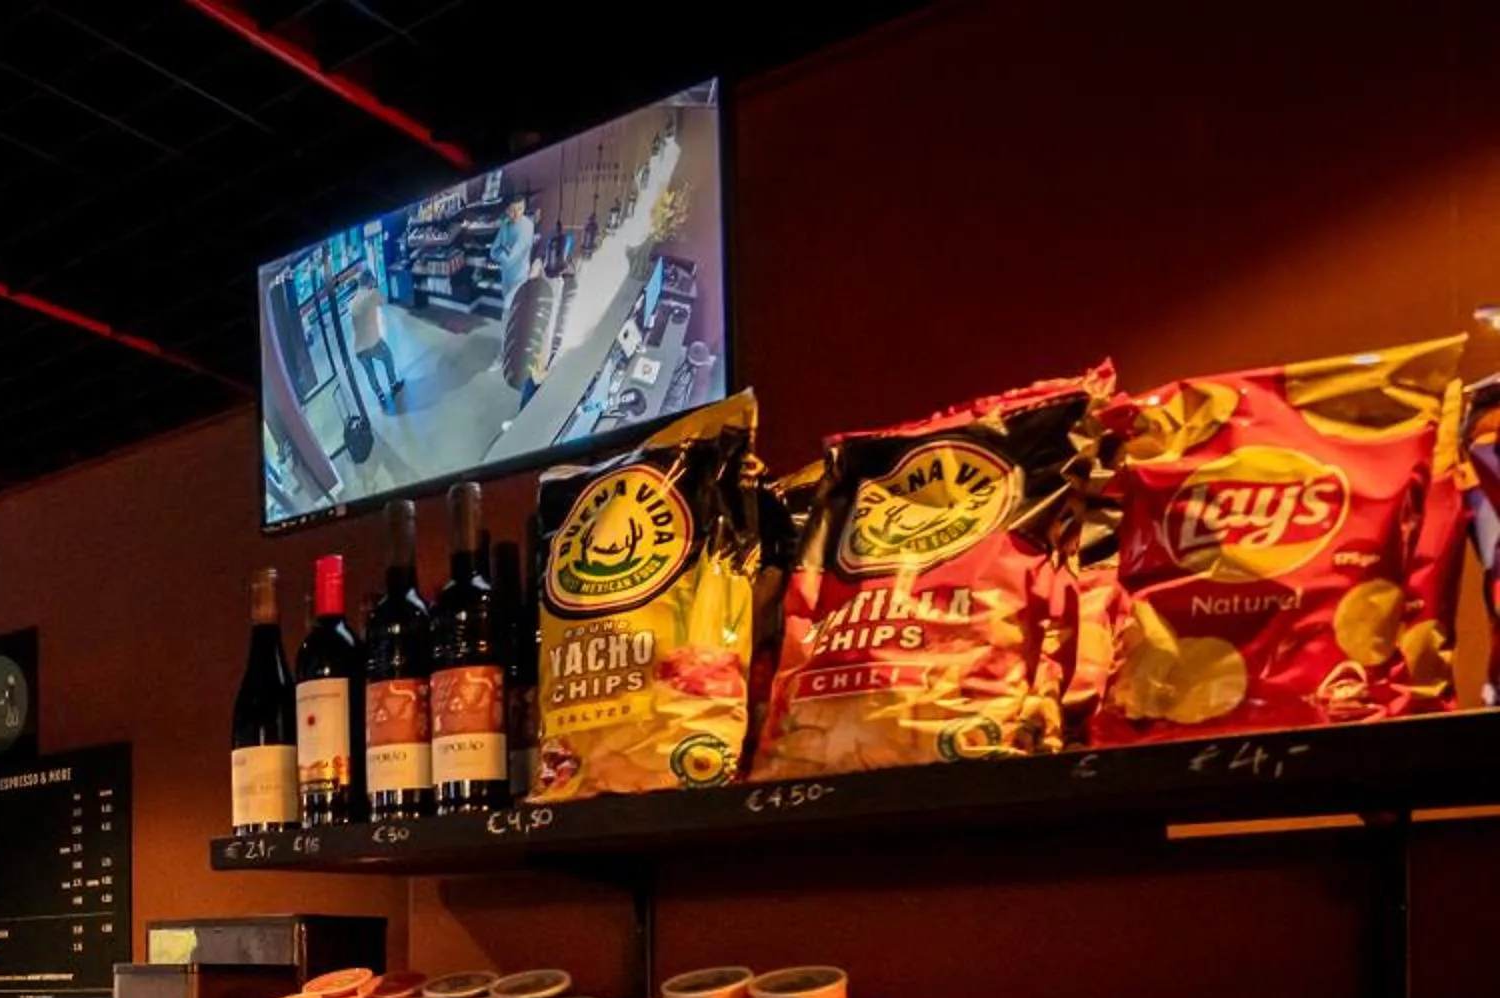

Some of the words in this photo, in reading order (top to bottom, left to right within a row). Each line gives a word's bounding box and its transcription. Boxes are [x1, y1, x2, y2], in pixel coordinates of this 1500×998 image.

[636, 483, 675, 547] VIDA
[551, 671, 644, 704] CHIPS
[811, 667, 901, 692] CHILI
